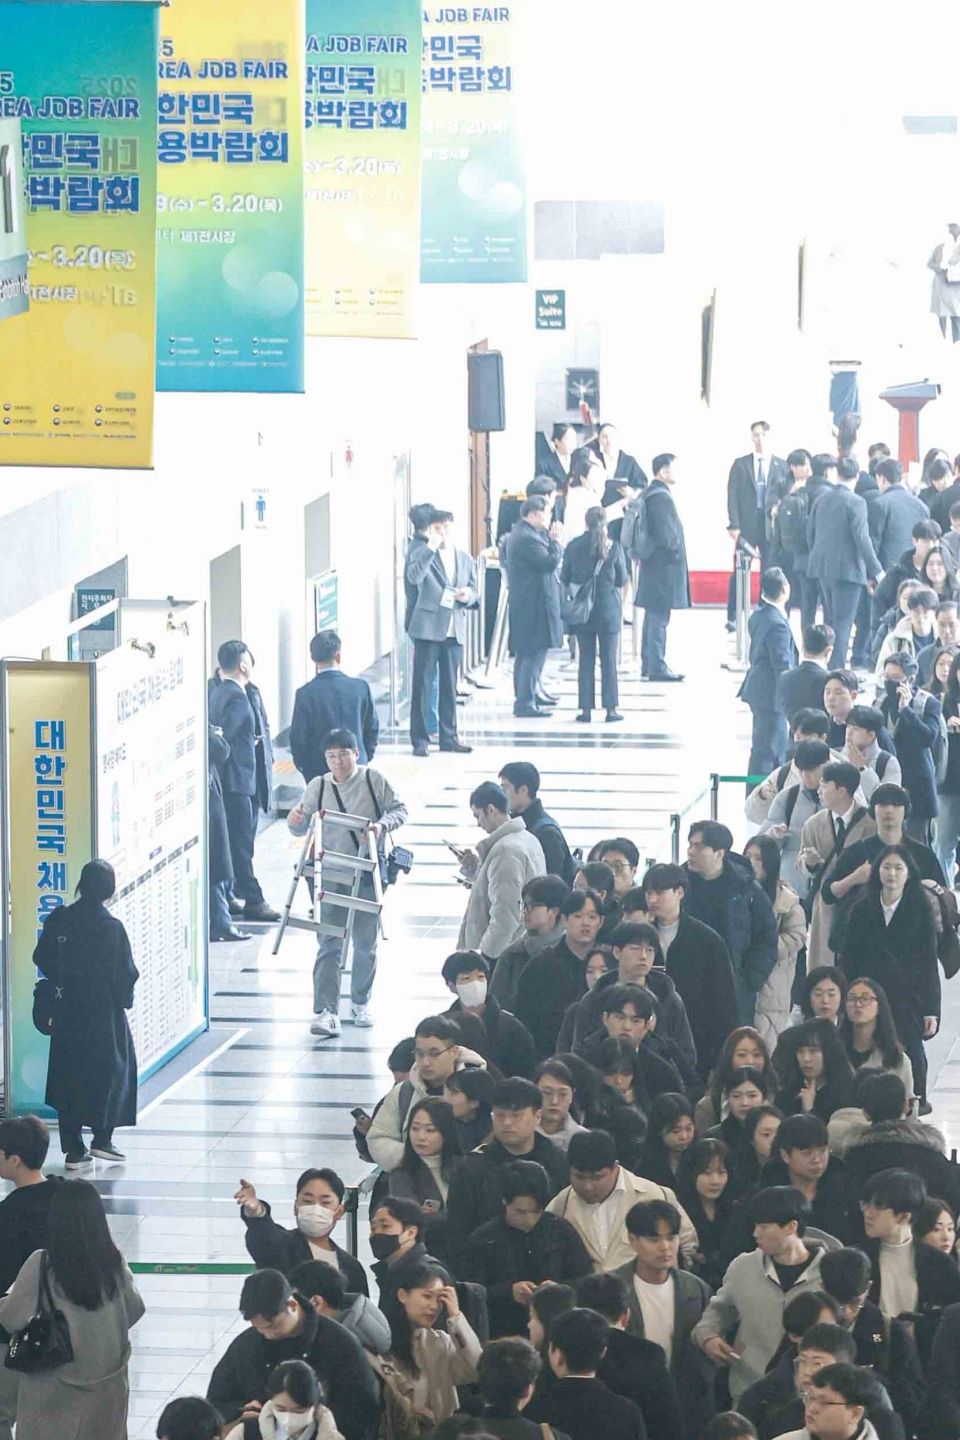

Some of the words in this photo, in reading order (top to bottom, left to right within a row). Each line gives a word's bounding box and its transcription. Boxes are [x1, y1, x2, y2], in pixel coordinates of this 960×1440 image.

[435, 8, 468, 24] JOB
[473, 7, 510, 23] FAIR
[325, 36, 362, 53] JOB
[366, 37, 408, 54] FAIR
[423, 35, 483, 61] 민국
[198, 61, 238, 79] JOB
[243, 61, 288, 79] FAIR
[423, 66, 513, 93] 박람회
[39, 97, 82, 118] JOB
[90, 98, 139, 118] FAIR
[158, 92, 254, 125] 한민국
[22, 133, 100, 170] 민국
[157, 130, 289, 163] 용박람회
[0, 145, 15, 233] 1
[25, 176, 139, 213] 박람회
[542, 294, 559, 305] VIP
[33, 719, 66, 855] 대한민국
